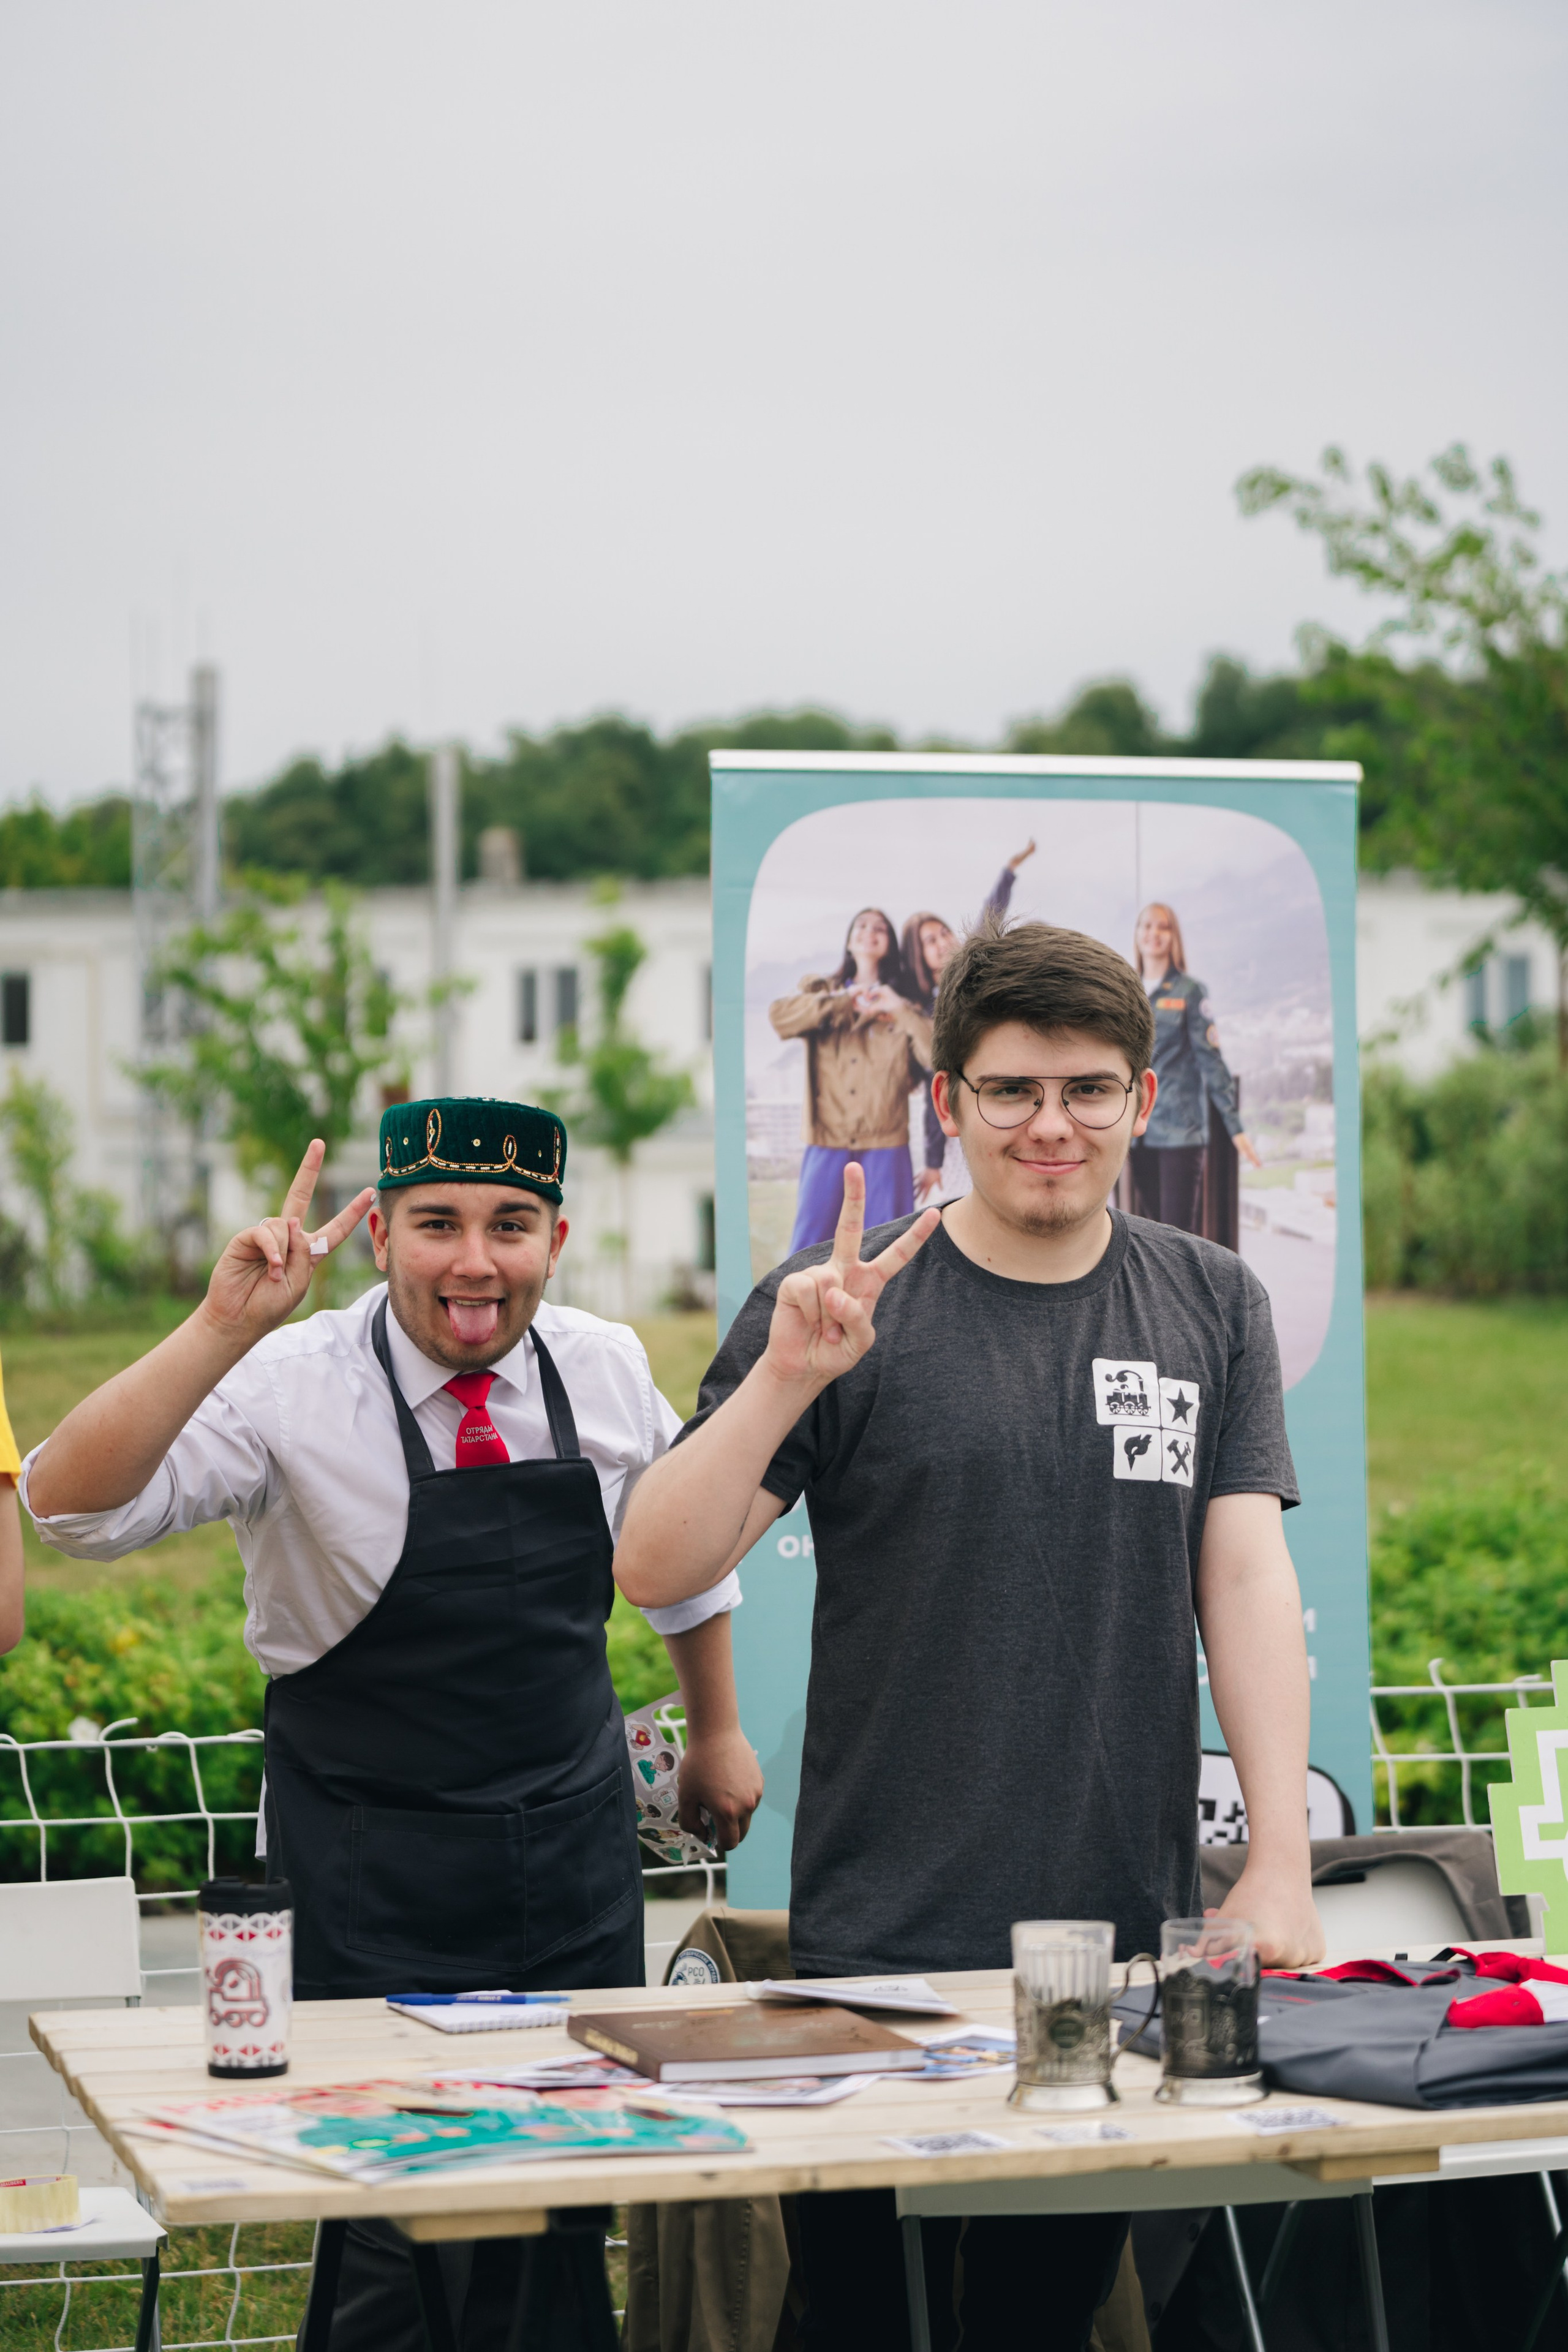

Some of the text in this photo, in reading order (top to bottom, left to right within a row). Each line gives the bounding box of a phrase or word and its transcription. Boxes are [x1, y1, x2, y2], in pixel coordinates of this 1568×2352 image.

[466, 1424, 493, 1434] ОТРЯДЫ
[461, 1432, 498, 1443] ТАТАРСТАНА
[688, 1967, 704, 1977] РСО
